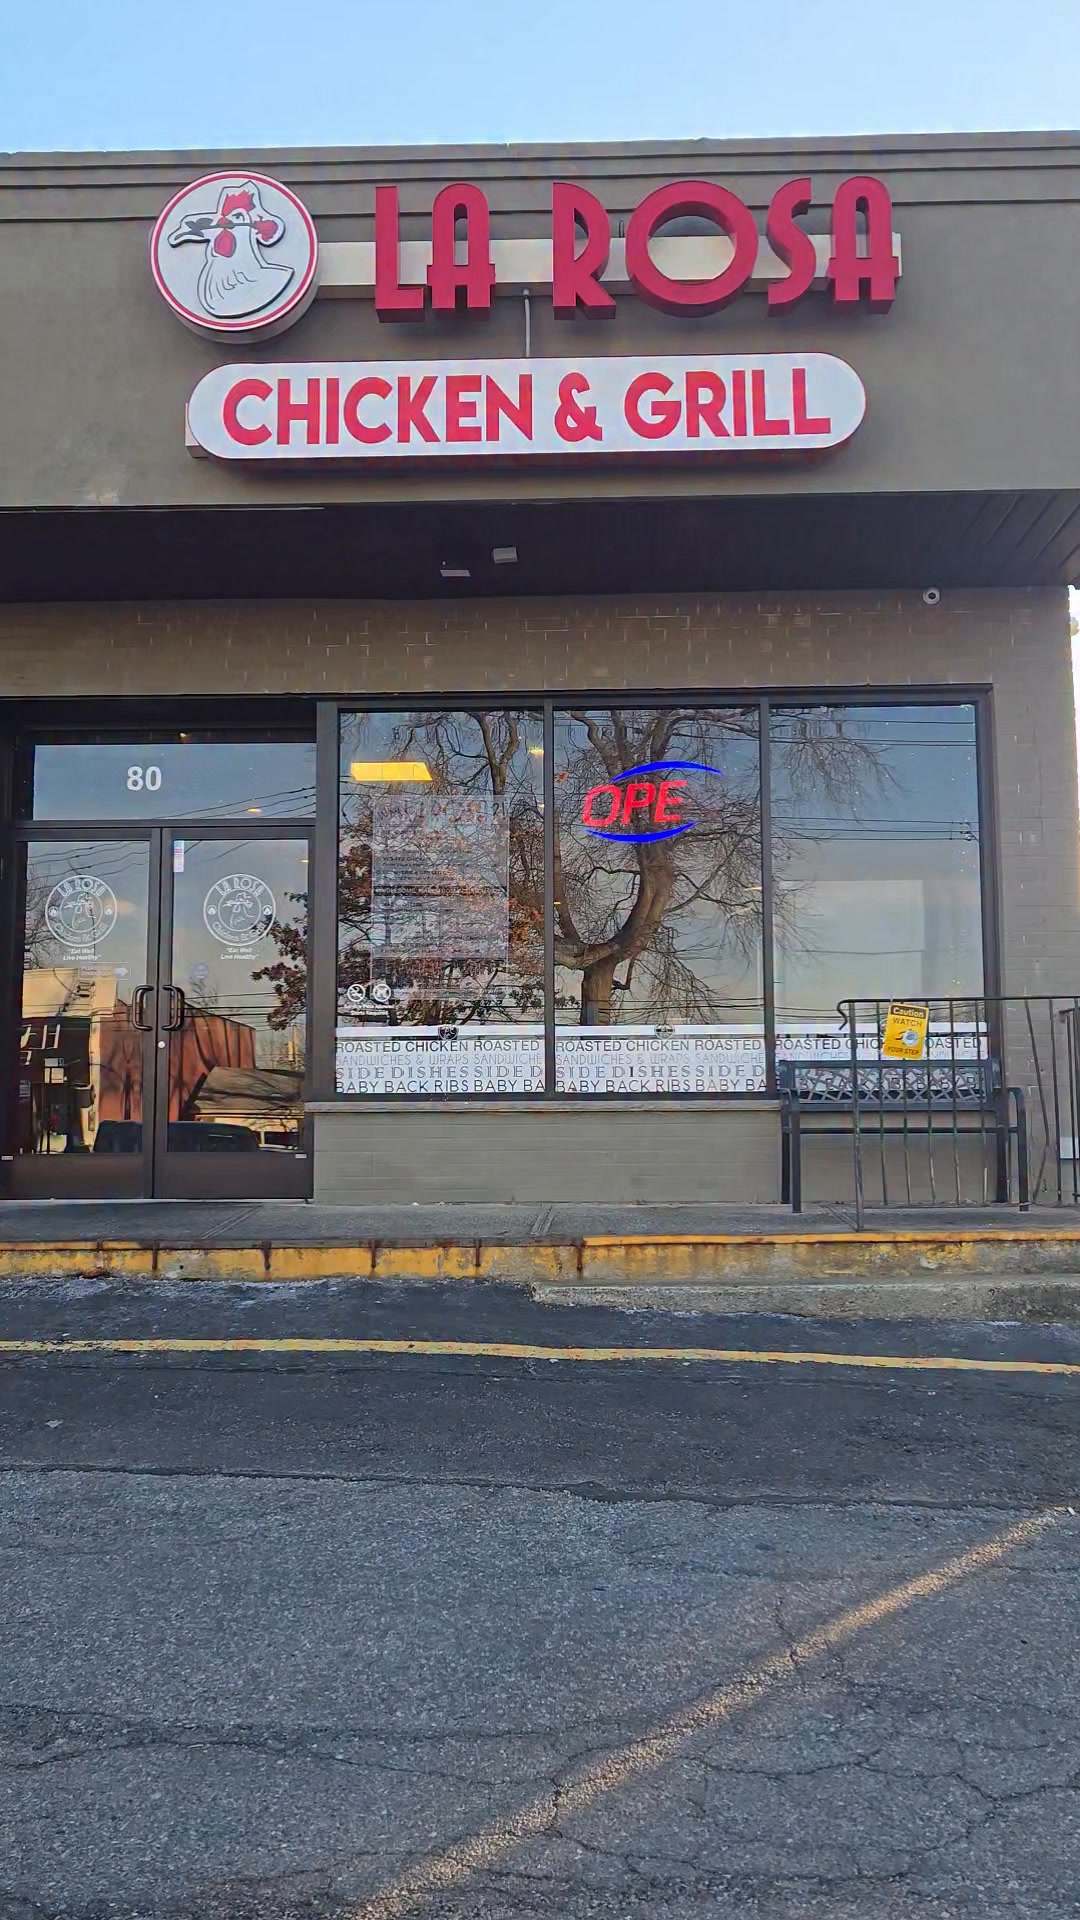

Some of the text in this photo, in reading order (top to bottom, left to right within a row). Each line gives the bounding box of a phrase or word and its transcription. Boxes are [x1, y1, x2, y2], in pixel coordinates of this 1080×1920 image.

[375, 176, 900, 322] LA ROSA
[222, 367, 832, 446] CHICKEN & GRILL
[126, 766, 162, 791] 80
[57, 878, 106, 897] LA ROSA
[215, 877, 265, 897] LA ROSA
[893, 1007, 924, 1018] Caution
[893, 1017, 922, 1027] WATCH
[336, 1040, 540, 1053] ROASTED CHICKEN ROASTED
[556, 1039, 761, 1052] ROASTED CHICKEN ROASTED
[776, 1038, 840, 1050] ROASTED
[336, 1054, 411, 1066] SANDWICHES
[415, 1054, 424, 1065] &
[429, 1054, 469, 1065] WRAPS
[556, 1053, 631, 1065] SANDWICHES
[637, 1053, 645, 1065] &
[650, 1053, 689, 1064] WRAPS
[336, 1067, 384, 1080] SIDE
[391, 1066, 469, 1079] DISHES
[474, 1066, 523, 1078] SIDE
[556, 1066, 607, 1079] SIDE
[612, 1066, 690, 1078] DISHES
[696, 1065, 746, 1077] SIDE
[336, 1079, 545, 1093] BABY BACK RIBS BABY BA
[556, 1078, 767, 1093] BABY BACK RIBS BABY BA
